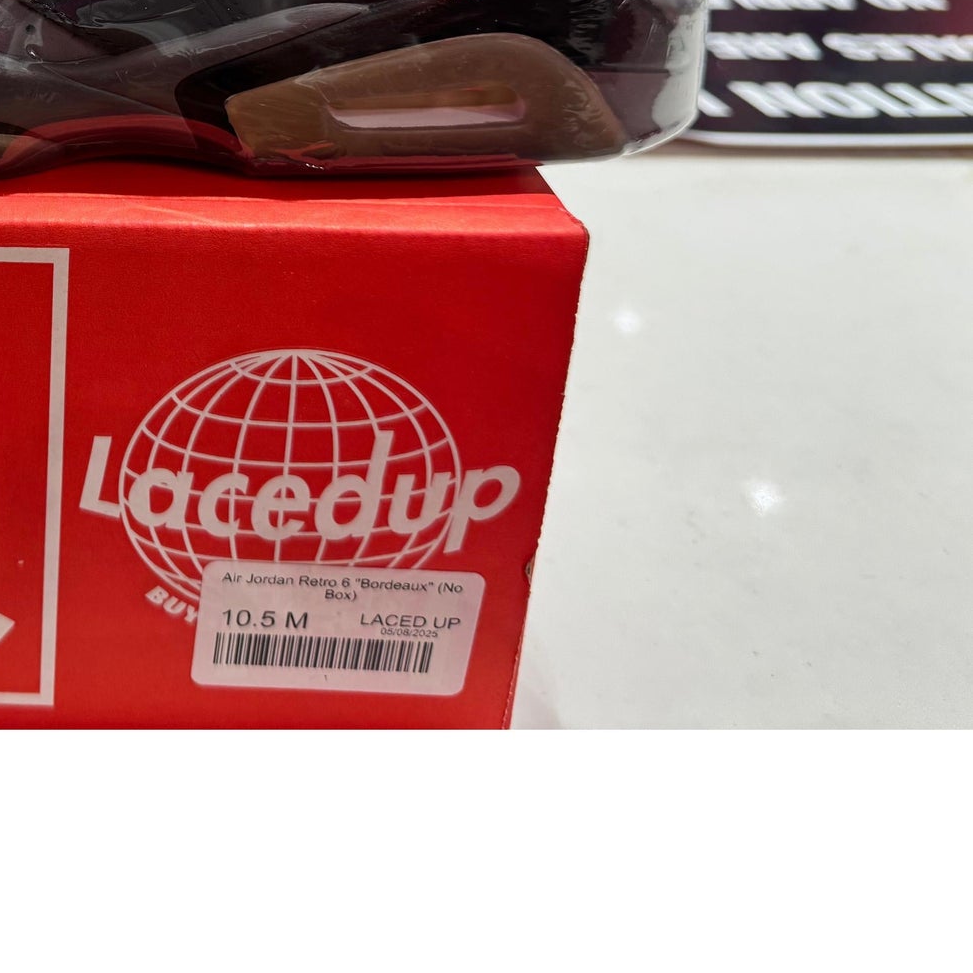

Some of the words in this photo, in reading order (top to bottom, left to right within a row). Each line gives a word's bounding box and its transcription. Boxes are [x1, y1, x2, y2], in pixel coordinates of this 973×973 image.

[79, 430, 521, 554] Lacedup
[222, 572, 242, 583] Air
[246, 573, 294, 585] Jordan
[298, 575, 337, 587] Retro
[341, 577, 350, 588] 6
[355, 578, 434, 592] "Bordeaux"
[438, 582, 463, 595] (No
[145, 585, 198, 623] BUY
[324, 588, 357, 601] Box)
[222, 609, 276, 628] 10.5
[285, 611, 309, 629] M
[360, 613, 427, 628] LACED
[433, 617, 461, 629] UP
[380, 627, 439, 638] 05/08/2025
